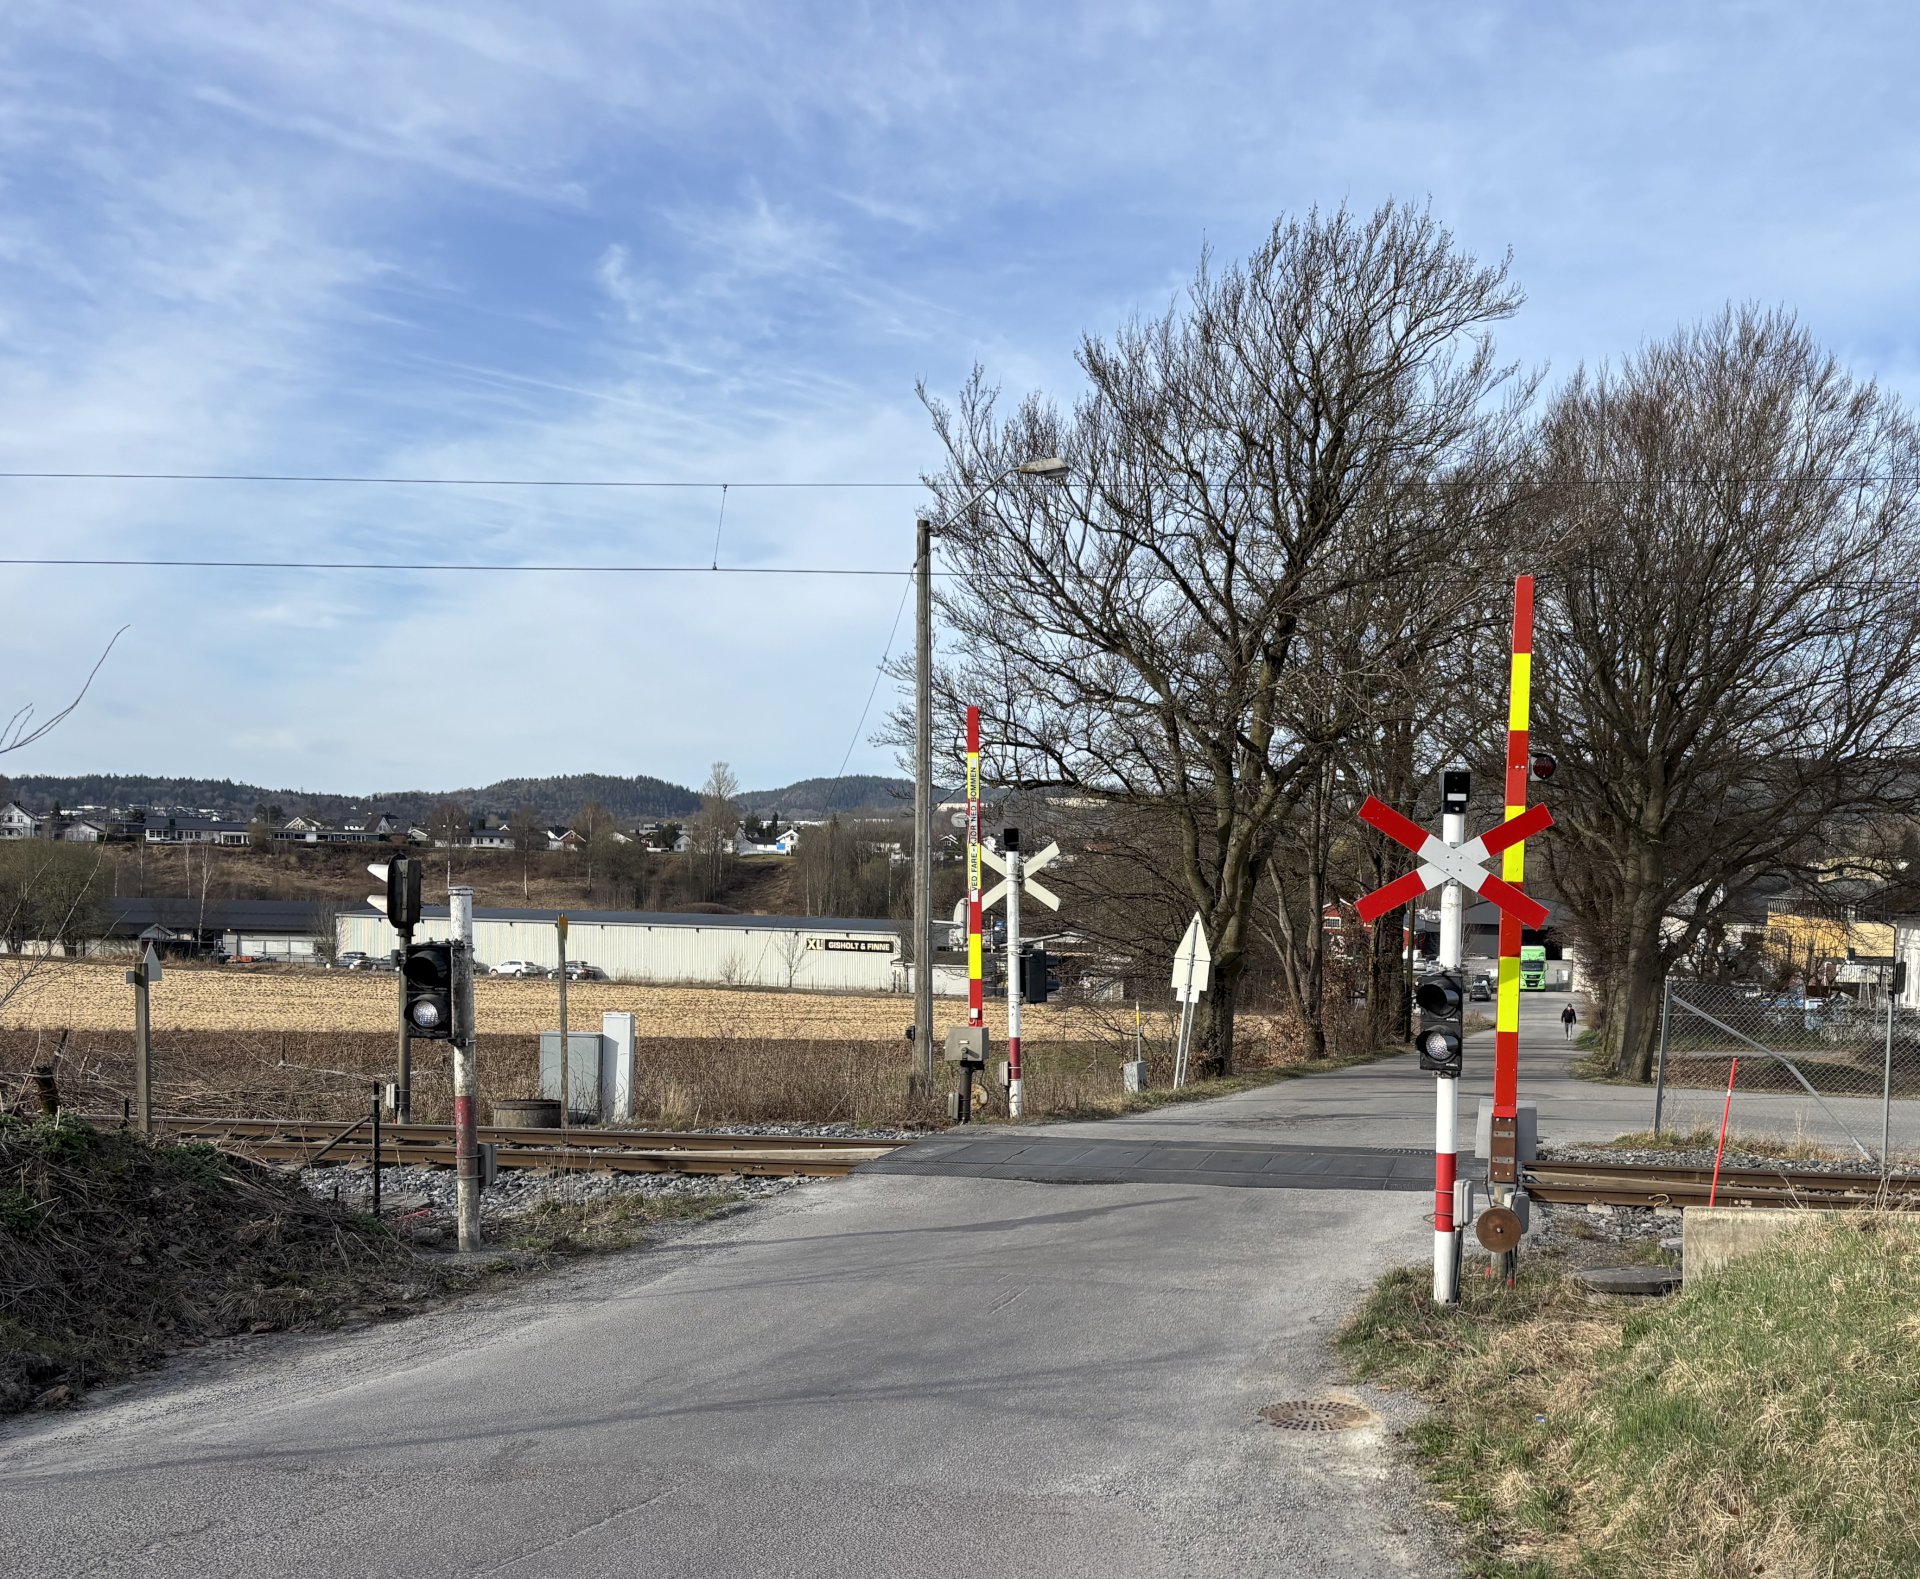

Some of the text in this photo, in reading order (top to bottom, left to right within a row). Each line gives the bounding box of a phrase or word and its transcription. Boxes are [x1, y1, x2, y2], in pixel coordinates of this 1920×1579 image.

[970, 853, 978, 873] FARE
[970, 875, 978, 892] VED
[807, 939, 824, 950] XL
[828, 941, 859, 950] GISHOLT
[867, 943, 890, 951] FINNE
